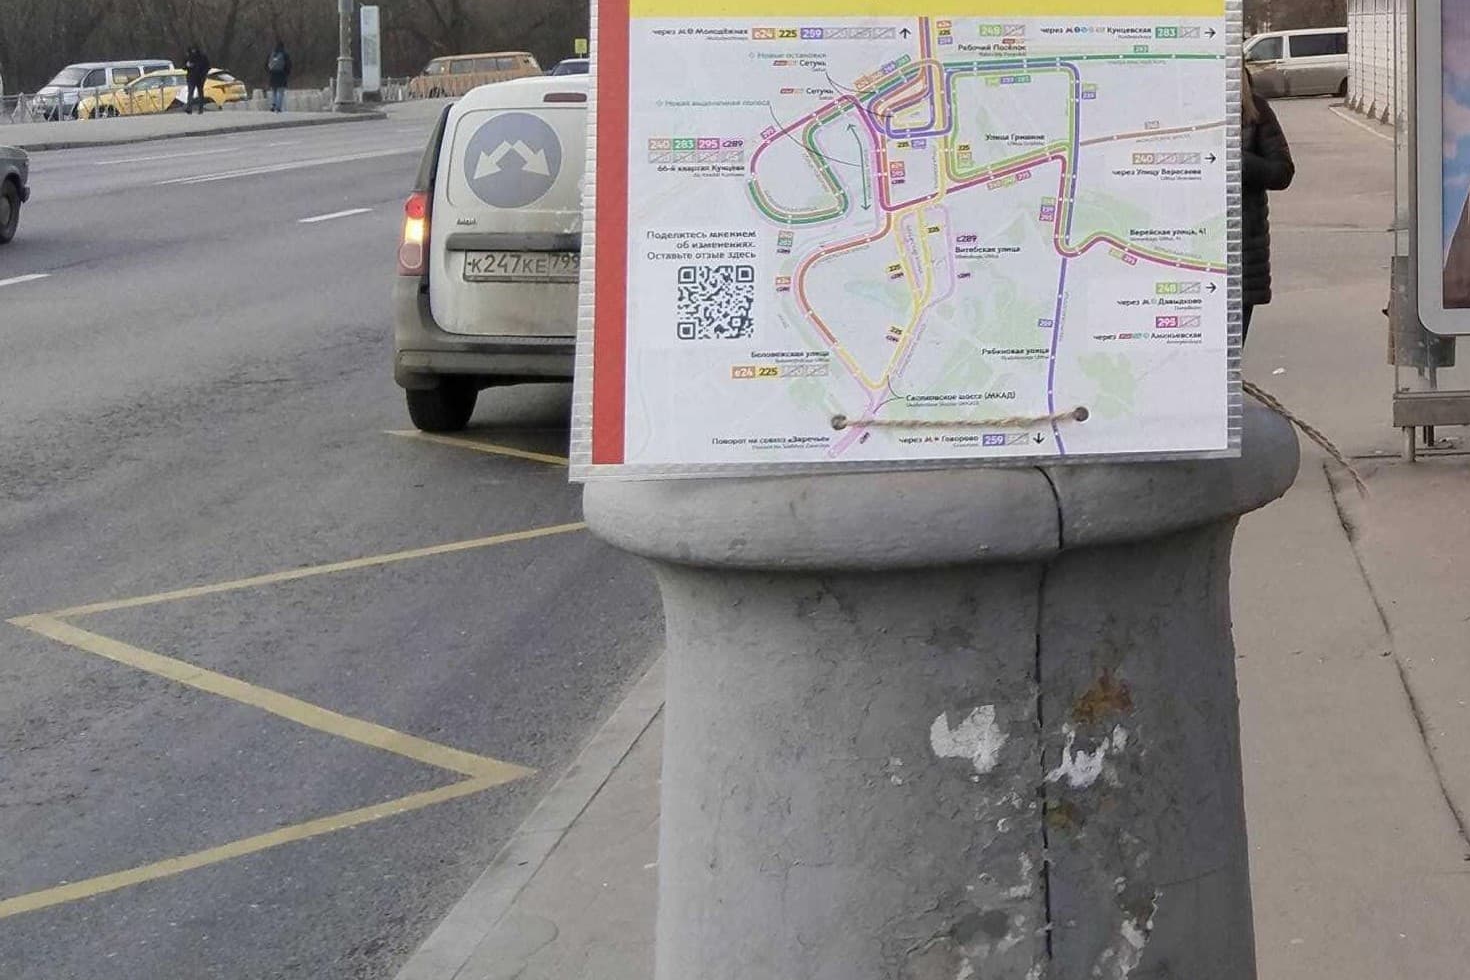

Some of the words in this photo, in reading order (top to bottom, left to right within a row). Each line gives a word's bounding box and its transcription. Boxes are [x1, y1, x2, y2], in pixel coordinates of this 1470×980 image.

[778, 29, 798, 39] 225
[698, 139, 719, 149] 295
[472, 253, 546, 273] К247КЕ
[758, 367, 777, 376] 225
[983, 435, 1004, 445] 259
